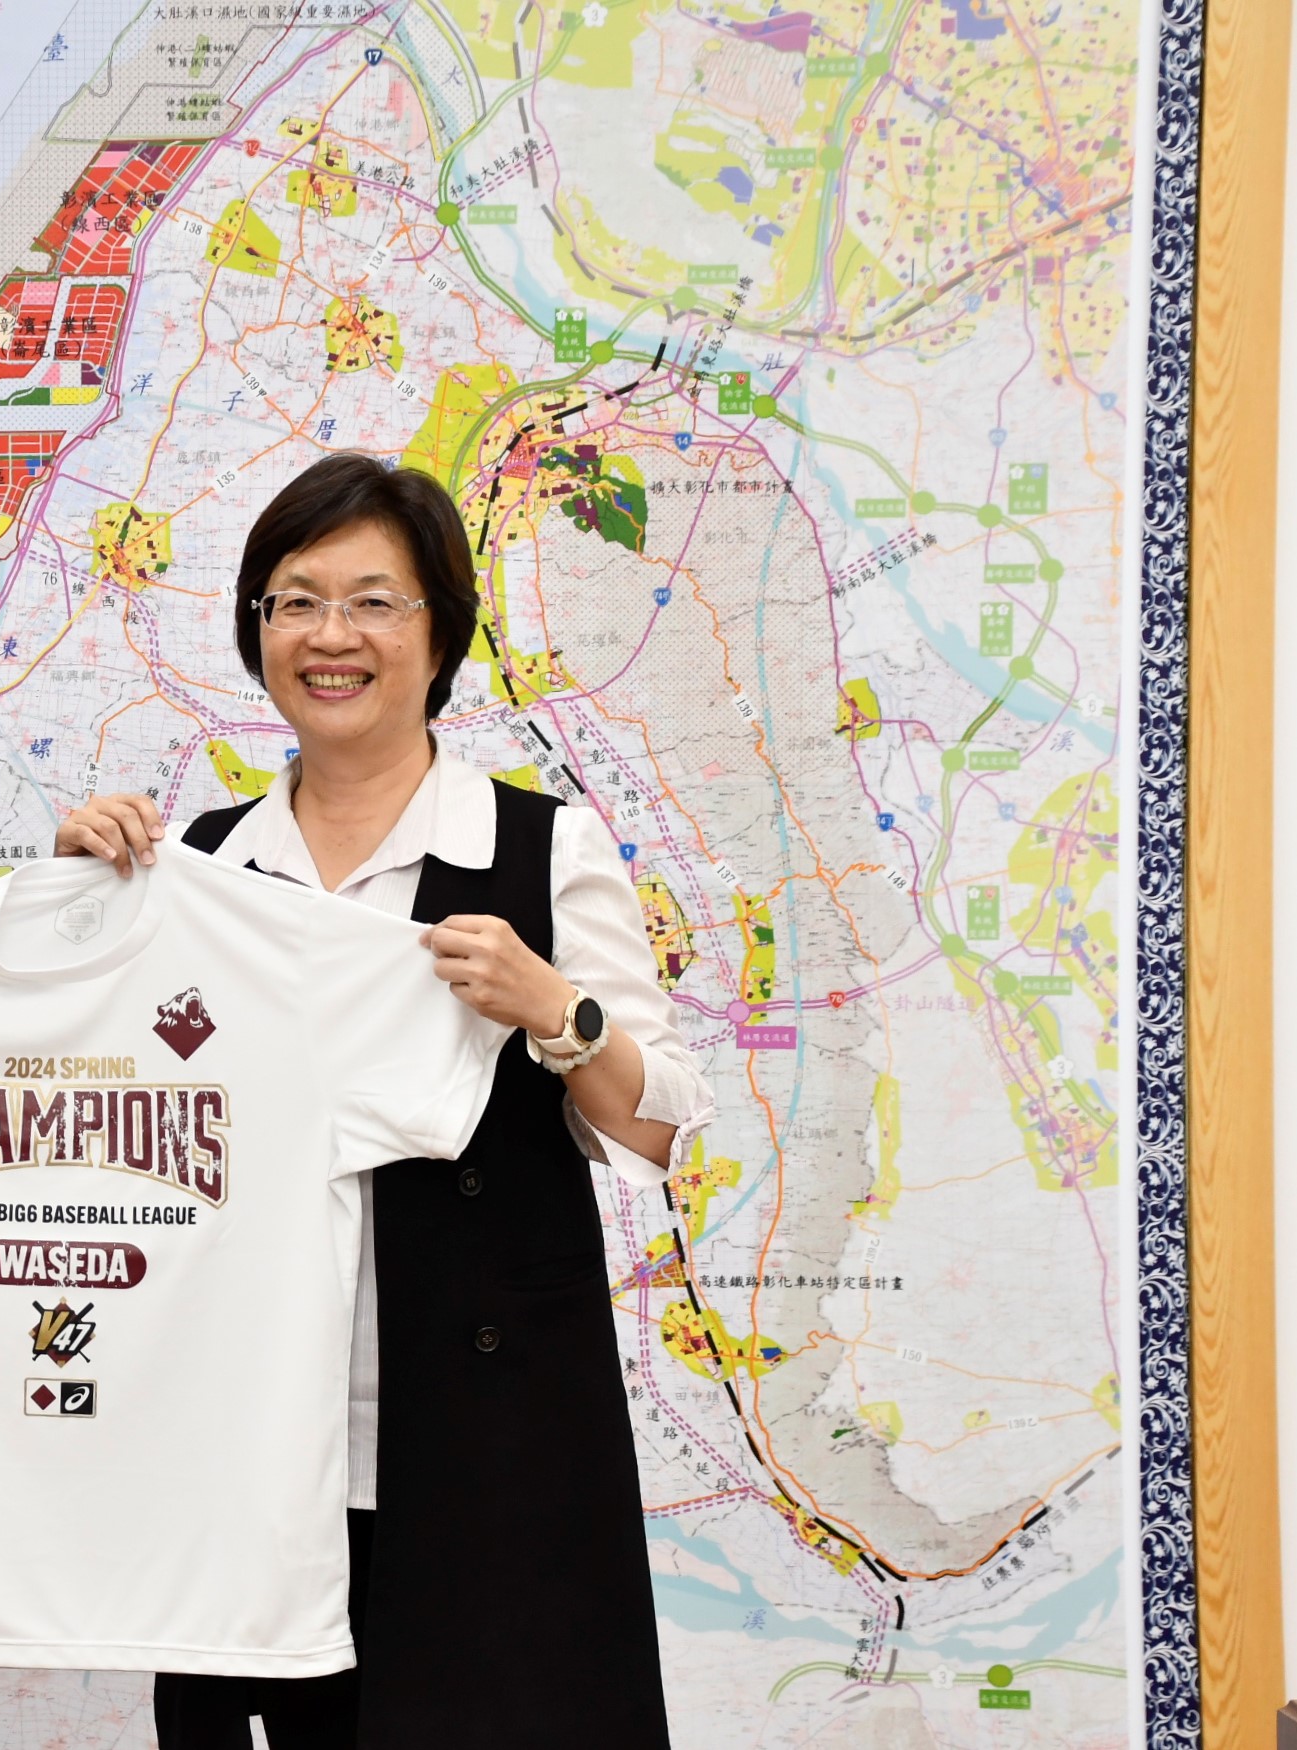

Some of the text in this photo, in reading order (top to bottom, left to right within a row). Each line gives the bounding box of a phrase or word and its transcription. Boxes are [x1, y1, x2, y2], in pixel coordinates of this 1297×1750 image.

[43, 33, 69, 63] 臺
[367, 51, 381, 60] 17
[449, 137, 540, 199] 和美大肚溪橋
[60, 190, 159, 209] 彰濱工業區
[182, 219, 203, 236] 138
[369, 250, 387, 271] 134
[428, 273, 447, 291] 139
[131, 372, 154, 394] 洋
[397, 380, 416, 398] 138
[223, 390, 245, 412] 子
[313, 417, 338, 442] 厝
[216, 471, 236, 488] 135
[651, 480, 795, 496] 擴大彰化市都市計畫
[832, 532, 938, 599] 彰南路大肚溪橋
[42, 571, 58, 586] 76
[736, 698, 753, 718] 139
[28, 738, 54, 760] 螺
[620, 807, 641, 821] 146
[716, 864, 736, 884] 137
[887, 870, 907, 890] 148
[5, 1056, 136, 1080] 2024 SPRING
[42, 1205, 128, 1225] BASEBALL
[132, 1206, 198, 1226] LEAGUE
[698, 1275, 905, 1291] 高速鐵路彰化車站特定區計畫
[52, 1321, 93, 1354] 47
[901, 1348, 922, 1362] 150
[625, 1357, 731, 1491] 東彰道路南延段
[844, 1618, 875, 1681] 彰雲大橋
